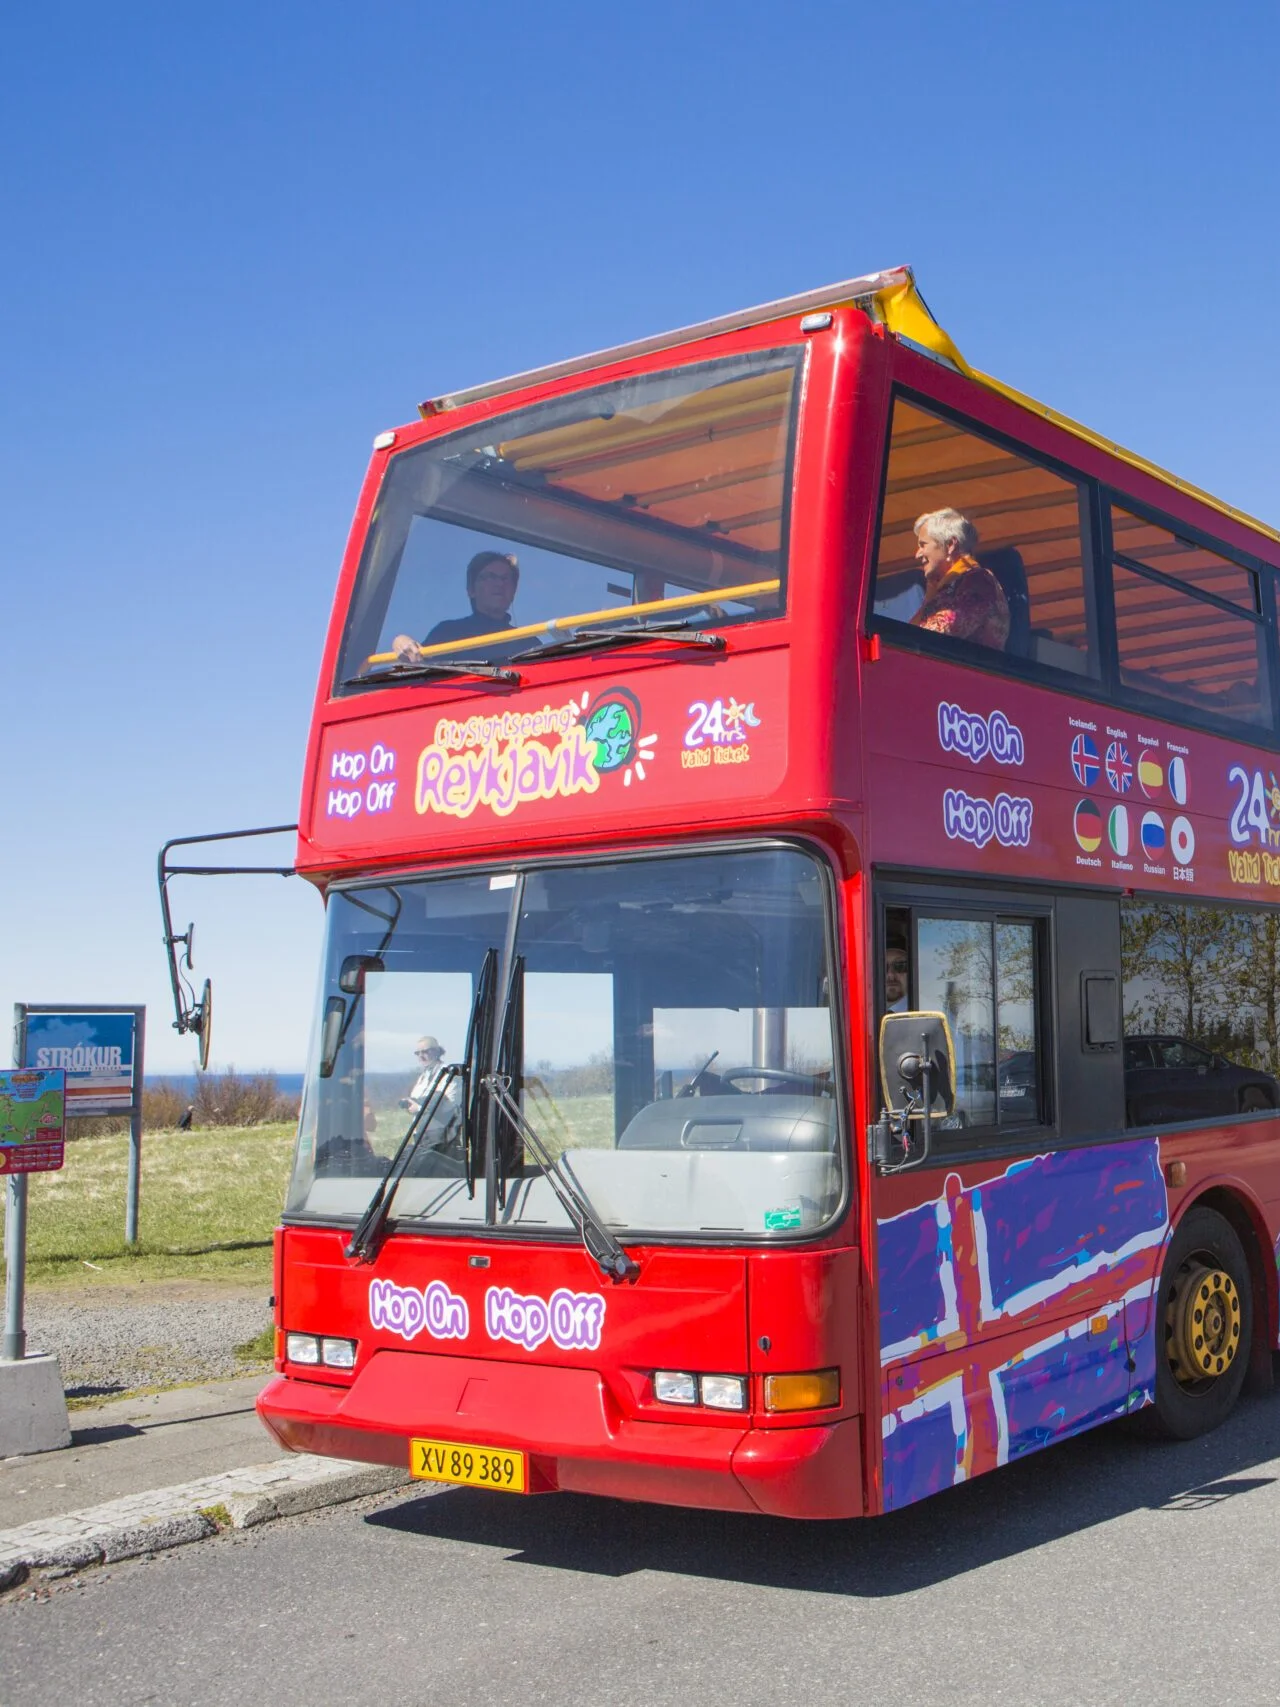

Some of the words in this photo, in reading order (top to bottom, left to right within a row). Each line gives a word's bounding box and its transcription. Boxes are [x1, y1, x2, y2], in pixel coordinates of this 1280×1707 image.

[939, 703, 988, 761] Hop
[989, 712, 1022, 763] On
[1069, 716, 1097, 731] Icelandic
[1106, 726, 1128, 739] English
[1137, 734, 1160, 747] Español
[1166, 741, 1189, 754] Français
[331, 751, 366, 780] Hop
[370, 744, 395, 774] On
[681, 747, 711, 768] Valid
[713, 743, 750, 764] Ticket
[417, 729, 597, 814] Reykjavik
[326, 789, 362, 818] Hop
[366, 782, 396, 812] Off
[1229, 766, 1267, 843] 24
[944, 790, 993, 846] Hop
[995, 794, 1032, 845] Off
[1076, 855, 1101, 867] Deutsch
[1111, 860, 1134, 871] Italiano
[1143, 863, 1166, 875] Russian
[1173, 866, 1194, 882] 日本語
[1228, 849, 1260, 884] Valid
[36, 1041, 121, 1068] STRÓKUR
[370, 1280, 424, 1338] Hop
[426, 1282, 467, 1337] On
[486, 1288, 547, 1349] Hop
[551, 1289, 604, 1348] Off
[421, 1447, 446, 1473] XV
[451, 1450, 473, 1478] 89
[479, 1455, 514, 1484] 389
